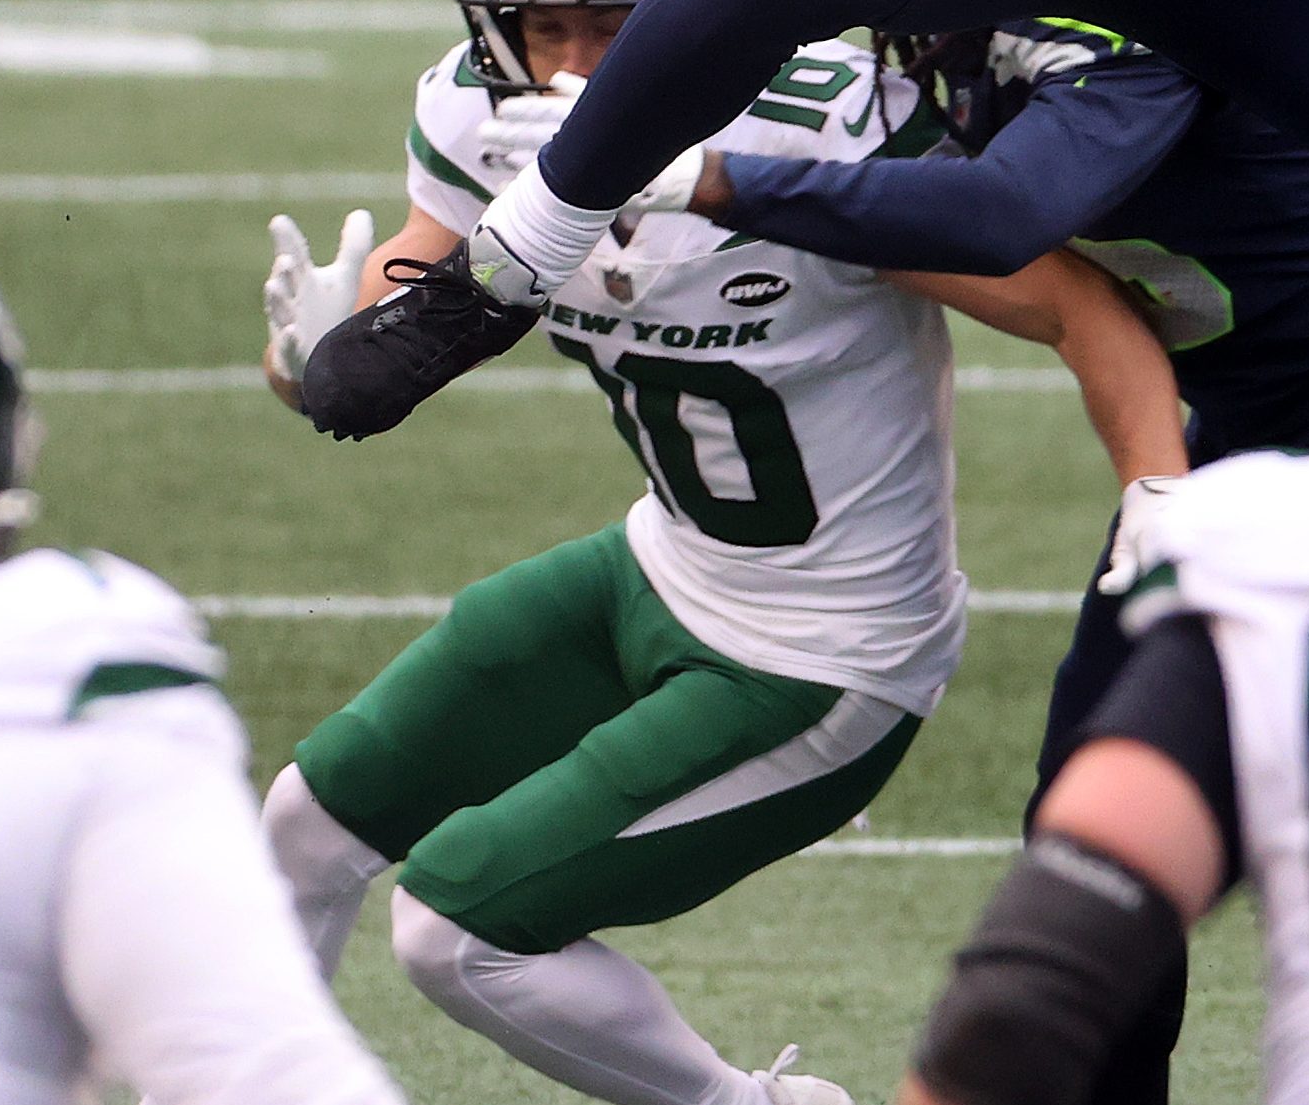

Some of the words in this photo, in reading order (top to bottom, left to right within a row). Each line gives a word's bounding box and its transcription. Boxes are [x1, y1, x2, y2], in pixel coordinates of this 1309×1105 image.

[747, 58, 861, 133] 10
[631, 318, 774, 350] YORK
[548, 331, 820, 548] 10
